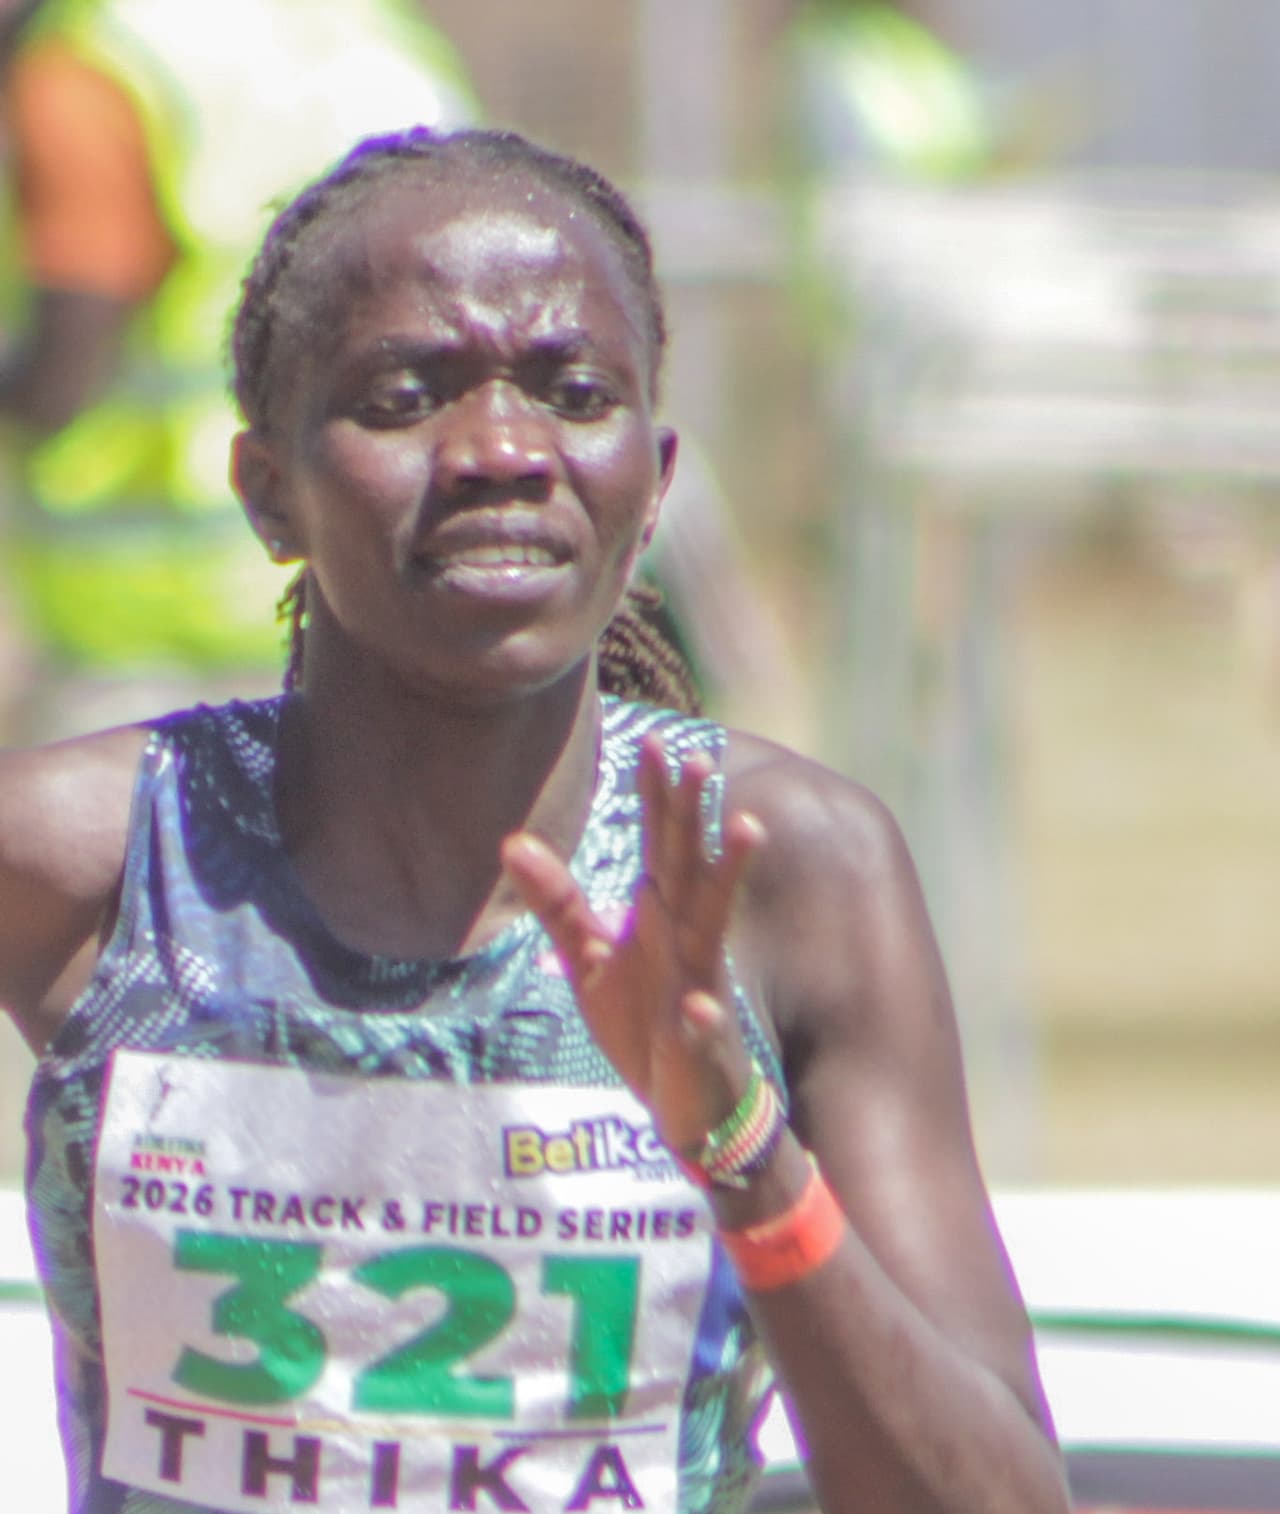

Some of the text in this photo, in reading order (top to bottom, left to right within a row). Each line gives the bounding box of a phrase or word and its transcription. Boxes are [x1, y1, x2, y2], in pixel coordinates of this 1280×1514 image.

[120, 1175, 697, 1242] 2026 TRACK & FIELD SERIES
[171, 1229, 641, 1420] 321
[144, 1407, 646, 1514] THIKA
